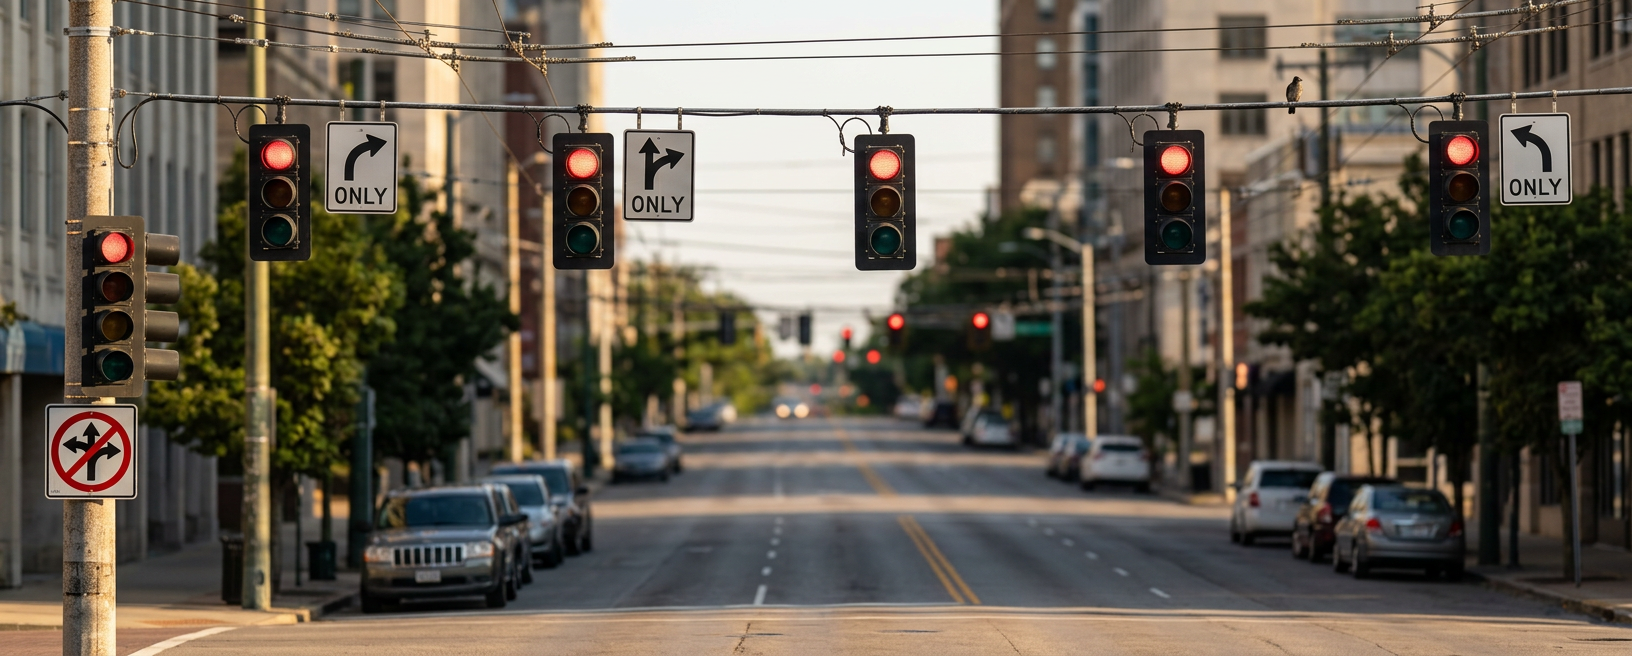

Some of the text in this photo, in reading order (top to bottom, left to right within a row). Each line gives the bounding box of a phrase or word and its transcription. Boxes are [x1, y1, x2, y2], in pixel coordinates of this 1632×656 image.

[335, 187, 387, 204] ONLY
[1510, 179, 1561, 196] ONLY
[632, 196, 684, 213] ONLY
